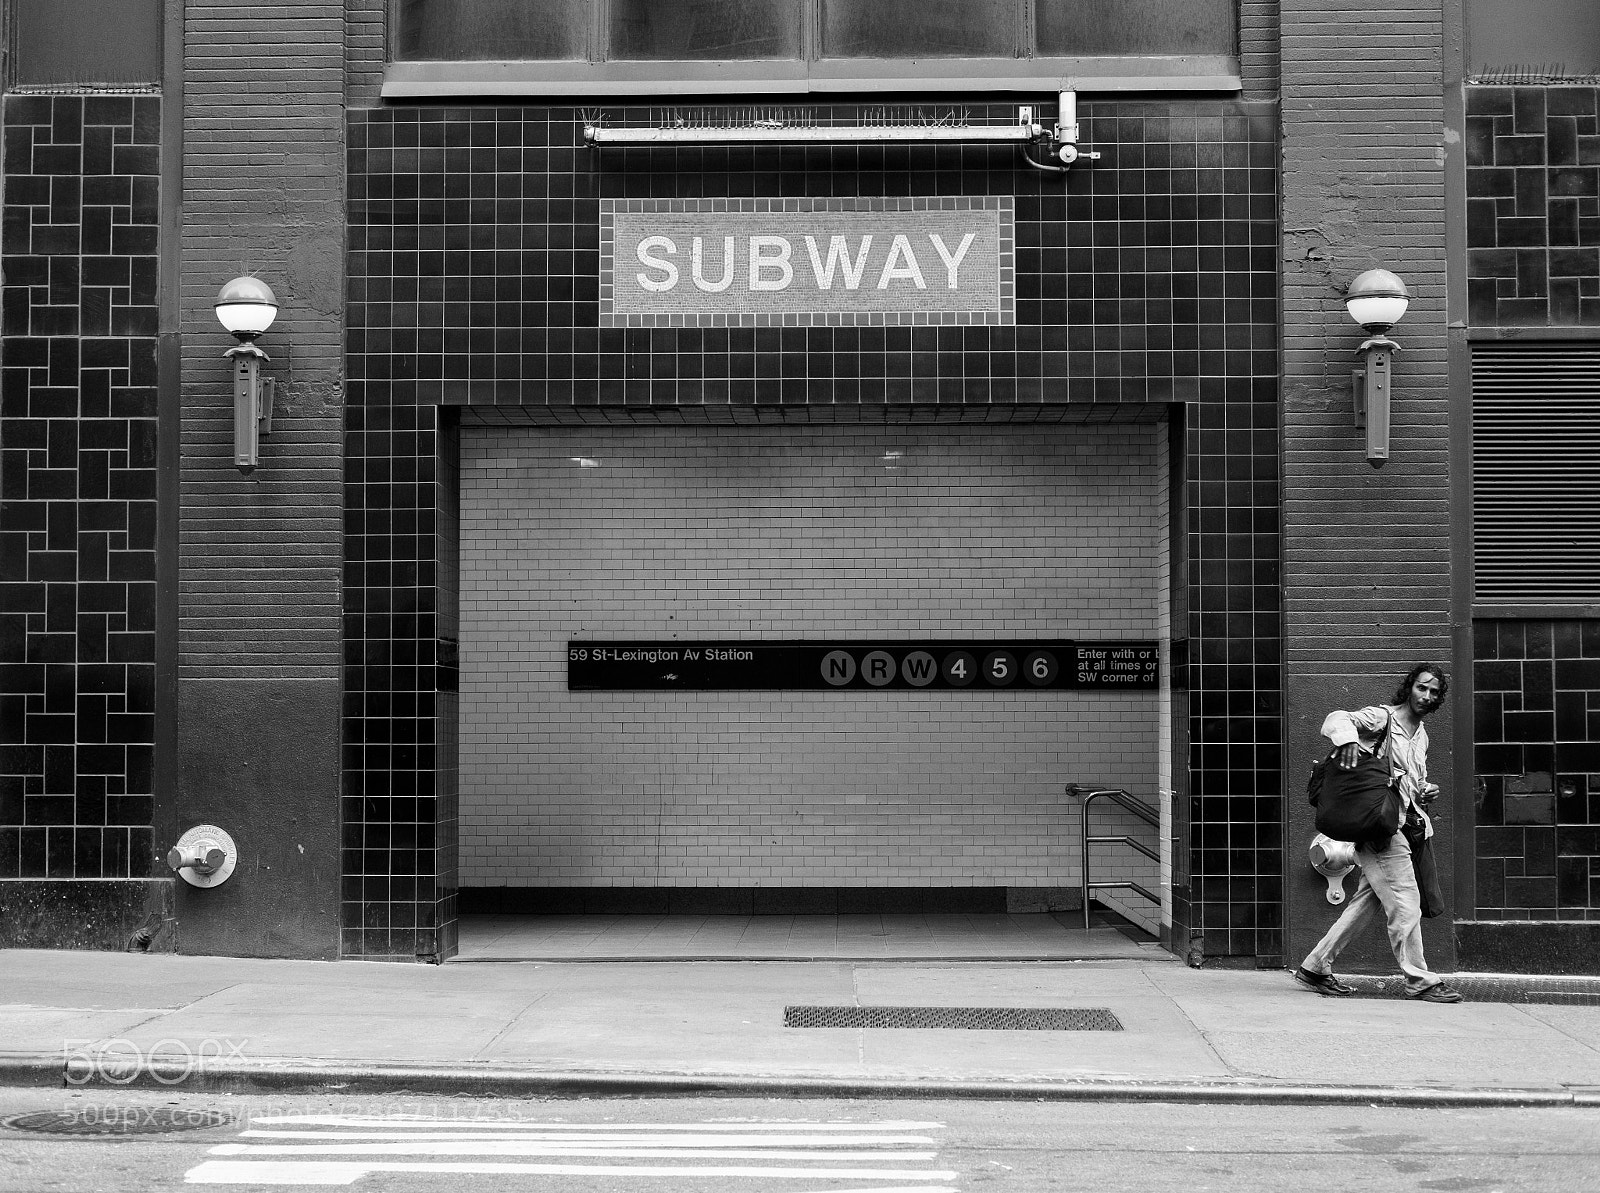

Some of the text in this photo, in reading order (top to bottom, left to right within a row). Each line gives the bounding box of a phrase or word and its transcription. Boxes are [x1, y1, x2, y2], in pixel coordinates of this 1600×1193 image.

[635, 233, 977, 293] SUBWAY
[569, 649, 754, 663] 59 St-Lexington Av Station
[1077, 648, 1107, 659] Enter
[1112, 648, 1135, 659] with
[1139, 651, 1151, 659] or
[829, 658, 1049, 678] N R W 4 5 6
[1077, 660, 1157, 671] at all times or
[1077, 672, 1155, 682] SW corner of
